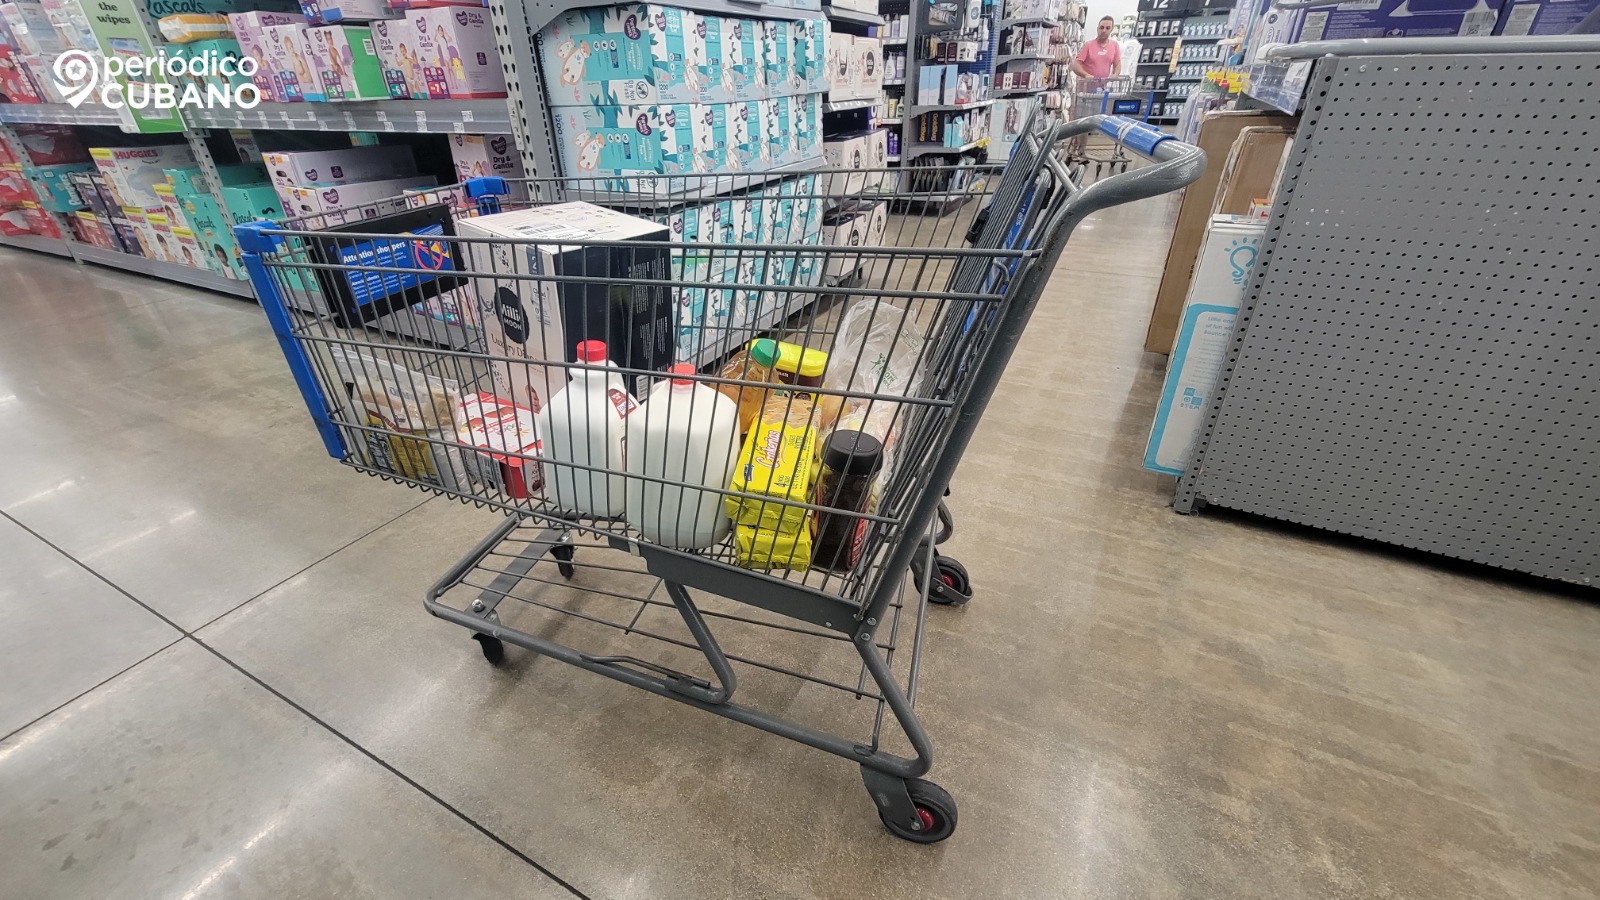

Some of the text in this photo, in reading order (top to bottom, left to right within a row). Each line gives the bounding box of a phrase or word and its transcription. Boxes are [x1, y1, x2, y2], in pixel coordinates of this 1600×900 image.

[97, 2, 119, 11] the
[96, 14, 131, 25] wipes
[434, 84, 440, 93] 7
[554, 113, 563, 135] 1200
[114, 149, 159, 160] HUGGIES
[493, 156, 505, 164] Dry
[492, 161, 514, 170] Gentle
[58, 174, 83, 206] Pampers
[193, 215, 217, 232] Rascals
[343, 249, 375, 265] Attention
[1180, 402, 1201, 410] STEM
